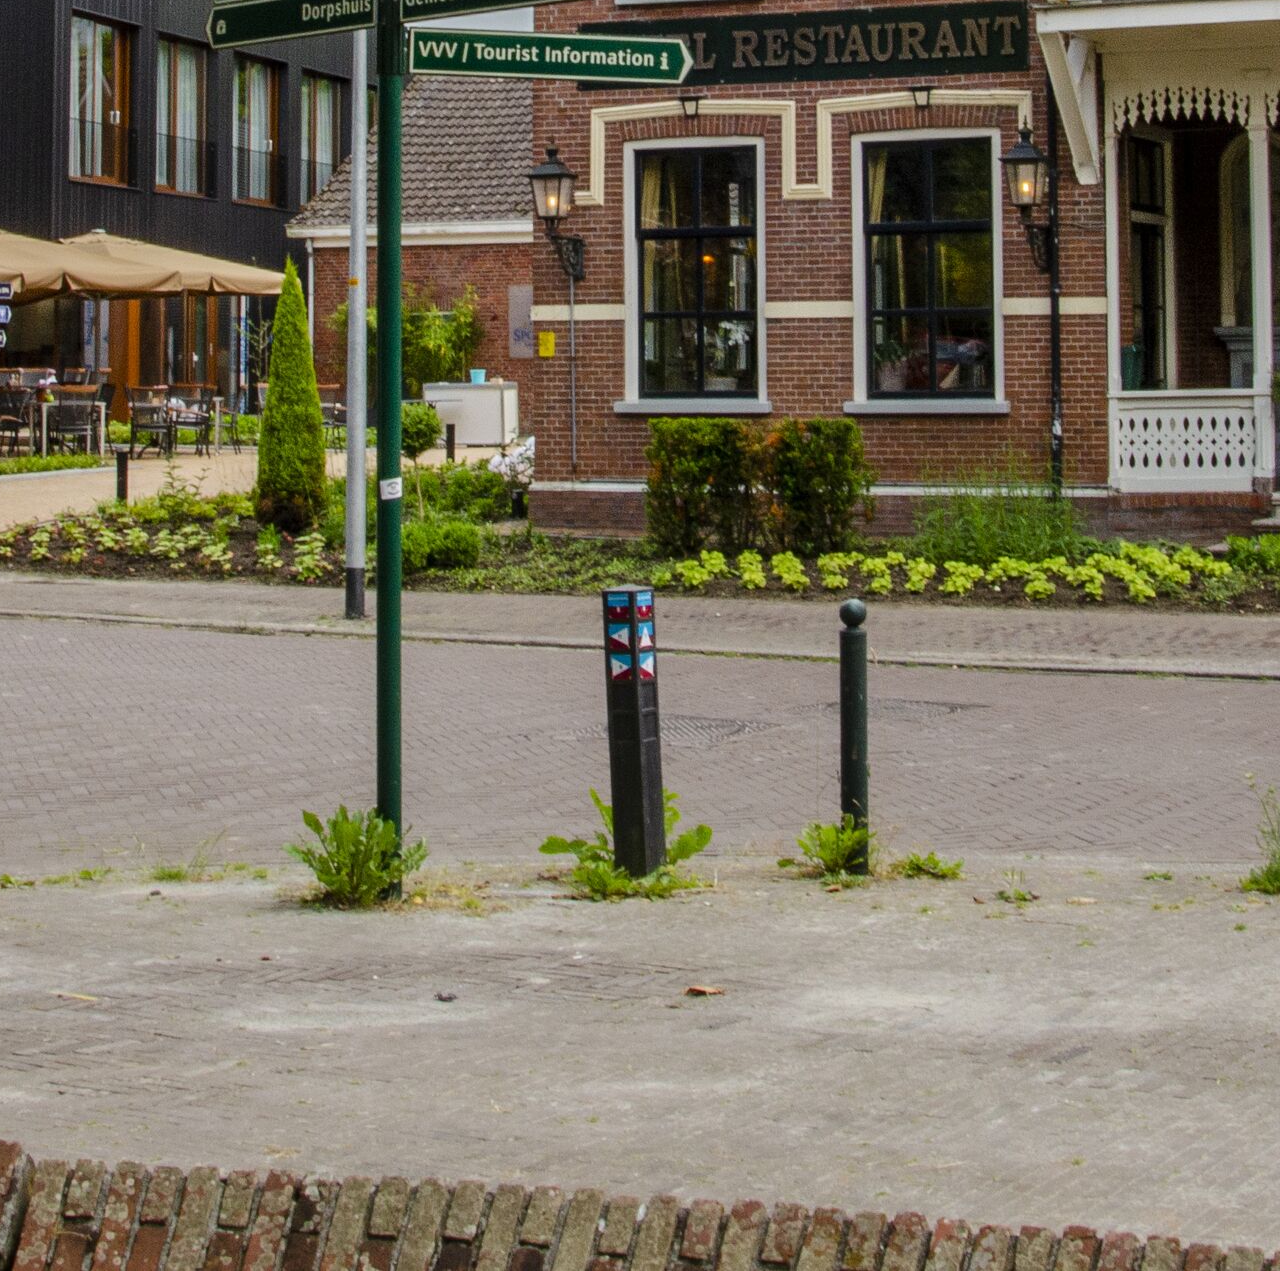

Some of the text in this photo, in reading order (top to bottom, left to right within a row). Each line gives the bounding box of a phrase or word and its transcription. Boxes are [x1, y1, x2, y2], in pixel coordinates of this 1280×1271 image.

[418, 40, 458, 58] VVV
[461, 42, 470, 63] /
[473, 42, 540, 62] Tourist
[544, 46, 655, 68] Information
[732, 16, 1020, 69] RESTAURANT
